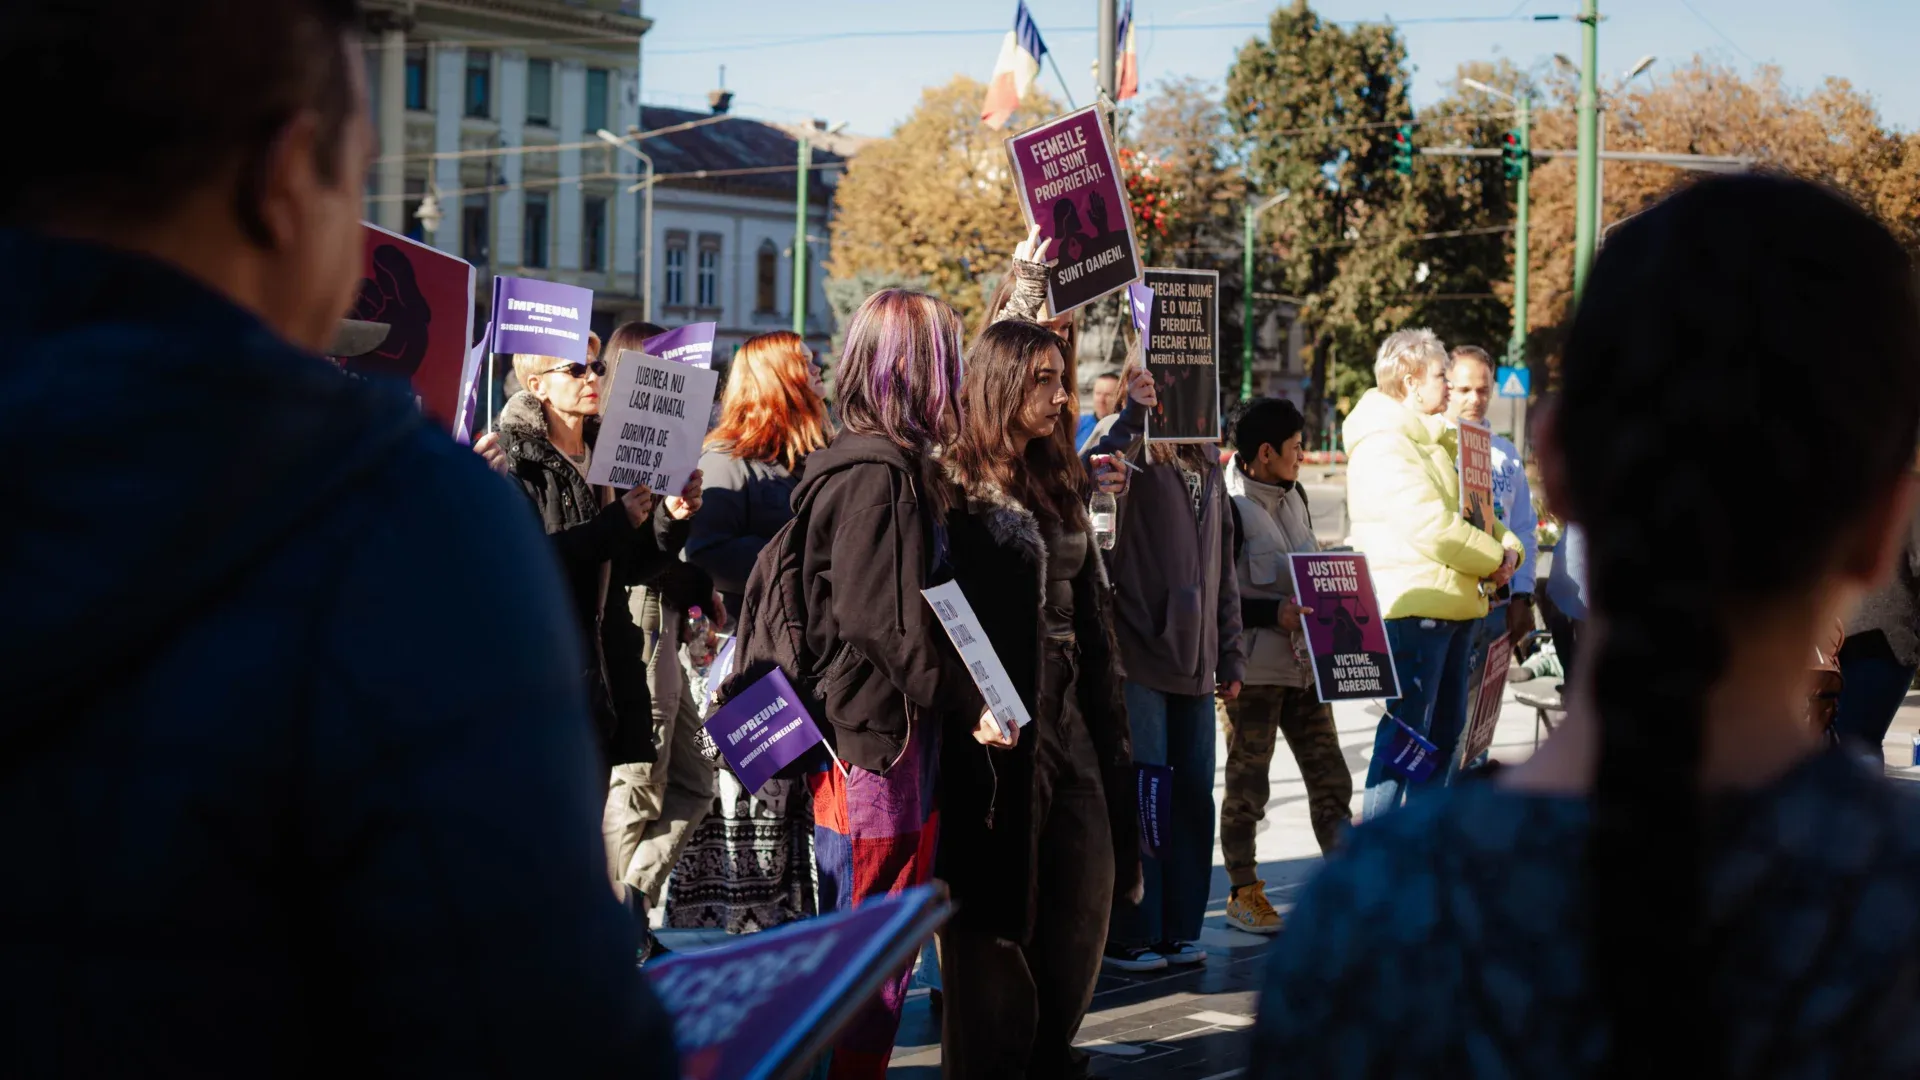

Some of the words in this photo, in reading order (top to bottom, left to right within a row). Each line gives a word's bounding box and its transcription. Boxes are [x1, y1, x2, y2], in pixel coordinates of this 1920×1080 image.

[1030, 126, 1087, 164] FEMEILE
[1042, 162, 1059, 180] NU
[1059, 148, 1088, 173] SUNT
[1034, 163, 1105, 204] PROPRIETĂȚI.
[1058, 262, 1084, 285] SUNT
[1086, 245, 1125, 273] OAMENI.
[1149, 282, 1186, 297] FIECARE
[1188, 284, 1213, 298] NUME
[1161, 300, 1167, 314] E
[1169, 301, 1176, 314] O
[1178, 299, 1203, 318] VIAȚĂ
[1160, 316, 1204, 332] PIERDUTĂ.
[1151, 335, 1187, 349] FIECARE
[1189, 334, 1212, 353] VIAȚĂ
[1150, 352, 1176, 364] MERITĂ
[1176, 352, 1185, 364] SĂ
[635, 366, 669, 390] IUBIREA
[671, 373, 685, 393] NU
[629, 390, 651, 411] LASA
[652, 395, 685, 420] VANATAI,
[621, 422, 656, 447] DORINȚA
[656, 430, 669, 447] DE
[615, 445, 653, 468] CONTROL
[653, 452, 663, 471] ȘI
[1471, 451, 1484, 468] NU
[608, 466, 653, 488] DOMINARE,
[655, 474, 670, 491] DA!
[1307, 561, 1357, 578] JUSTIȚIE
[1313, 577, 1358, 592] PENTRU
[1334, 653, 1373, 667] VICTIME,
[1332, 668, 1346, 679] NU
[1348, 666, 1380, 678] PENTRU
[1338, 679, 1382, 693] AGRESORI.
[727, 696, 788, 746] ÎMPREUNĂ
[749, 726, 769, 743] PENTRU
[740, 742, 770, 768] SIGURANȚA
